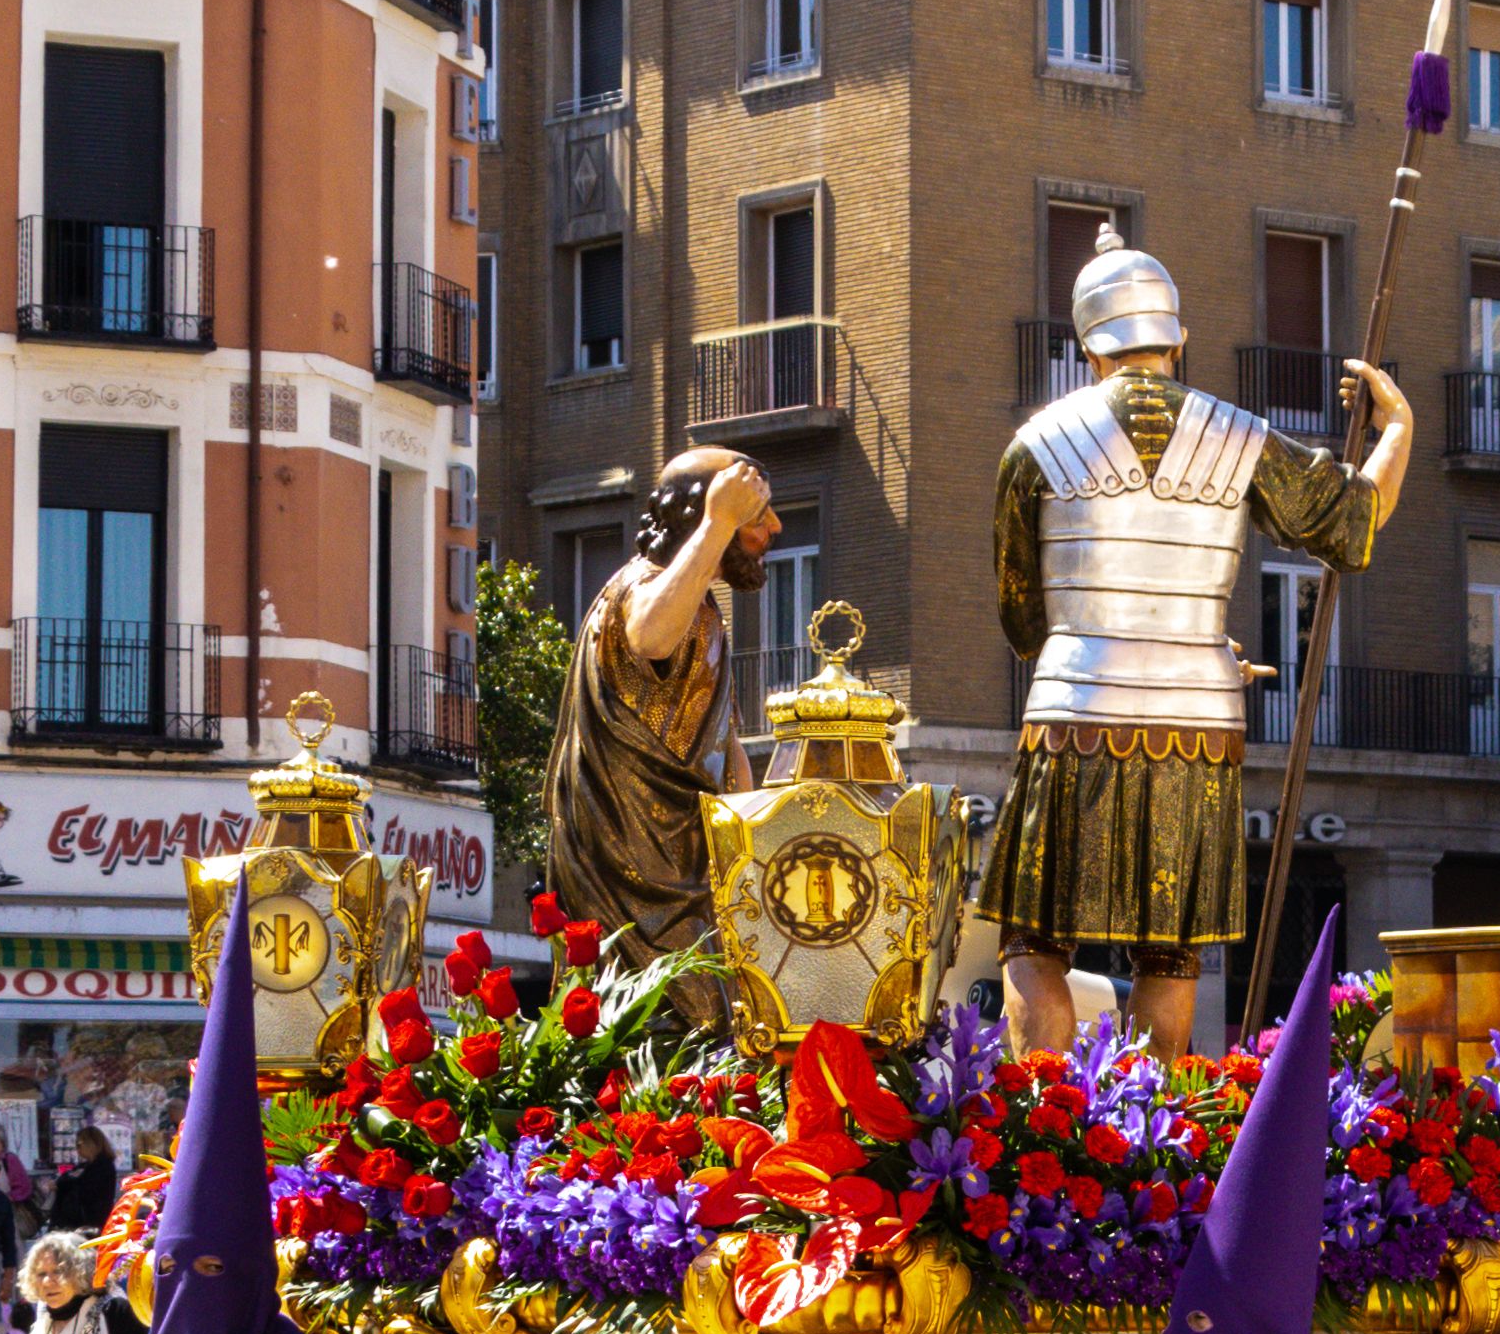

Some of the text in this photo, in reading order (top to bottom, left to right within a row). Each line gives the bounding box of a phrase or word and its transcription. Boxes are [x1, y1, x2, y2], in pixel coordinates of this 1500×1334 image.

[48, 804, 252, 871] EL MAÑ
[409, 823, 485, 890] MAÑO
